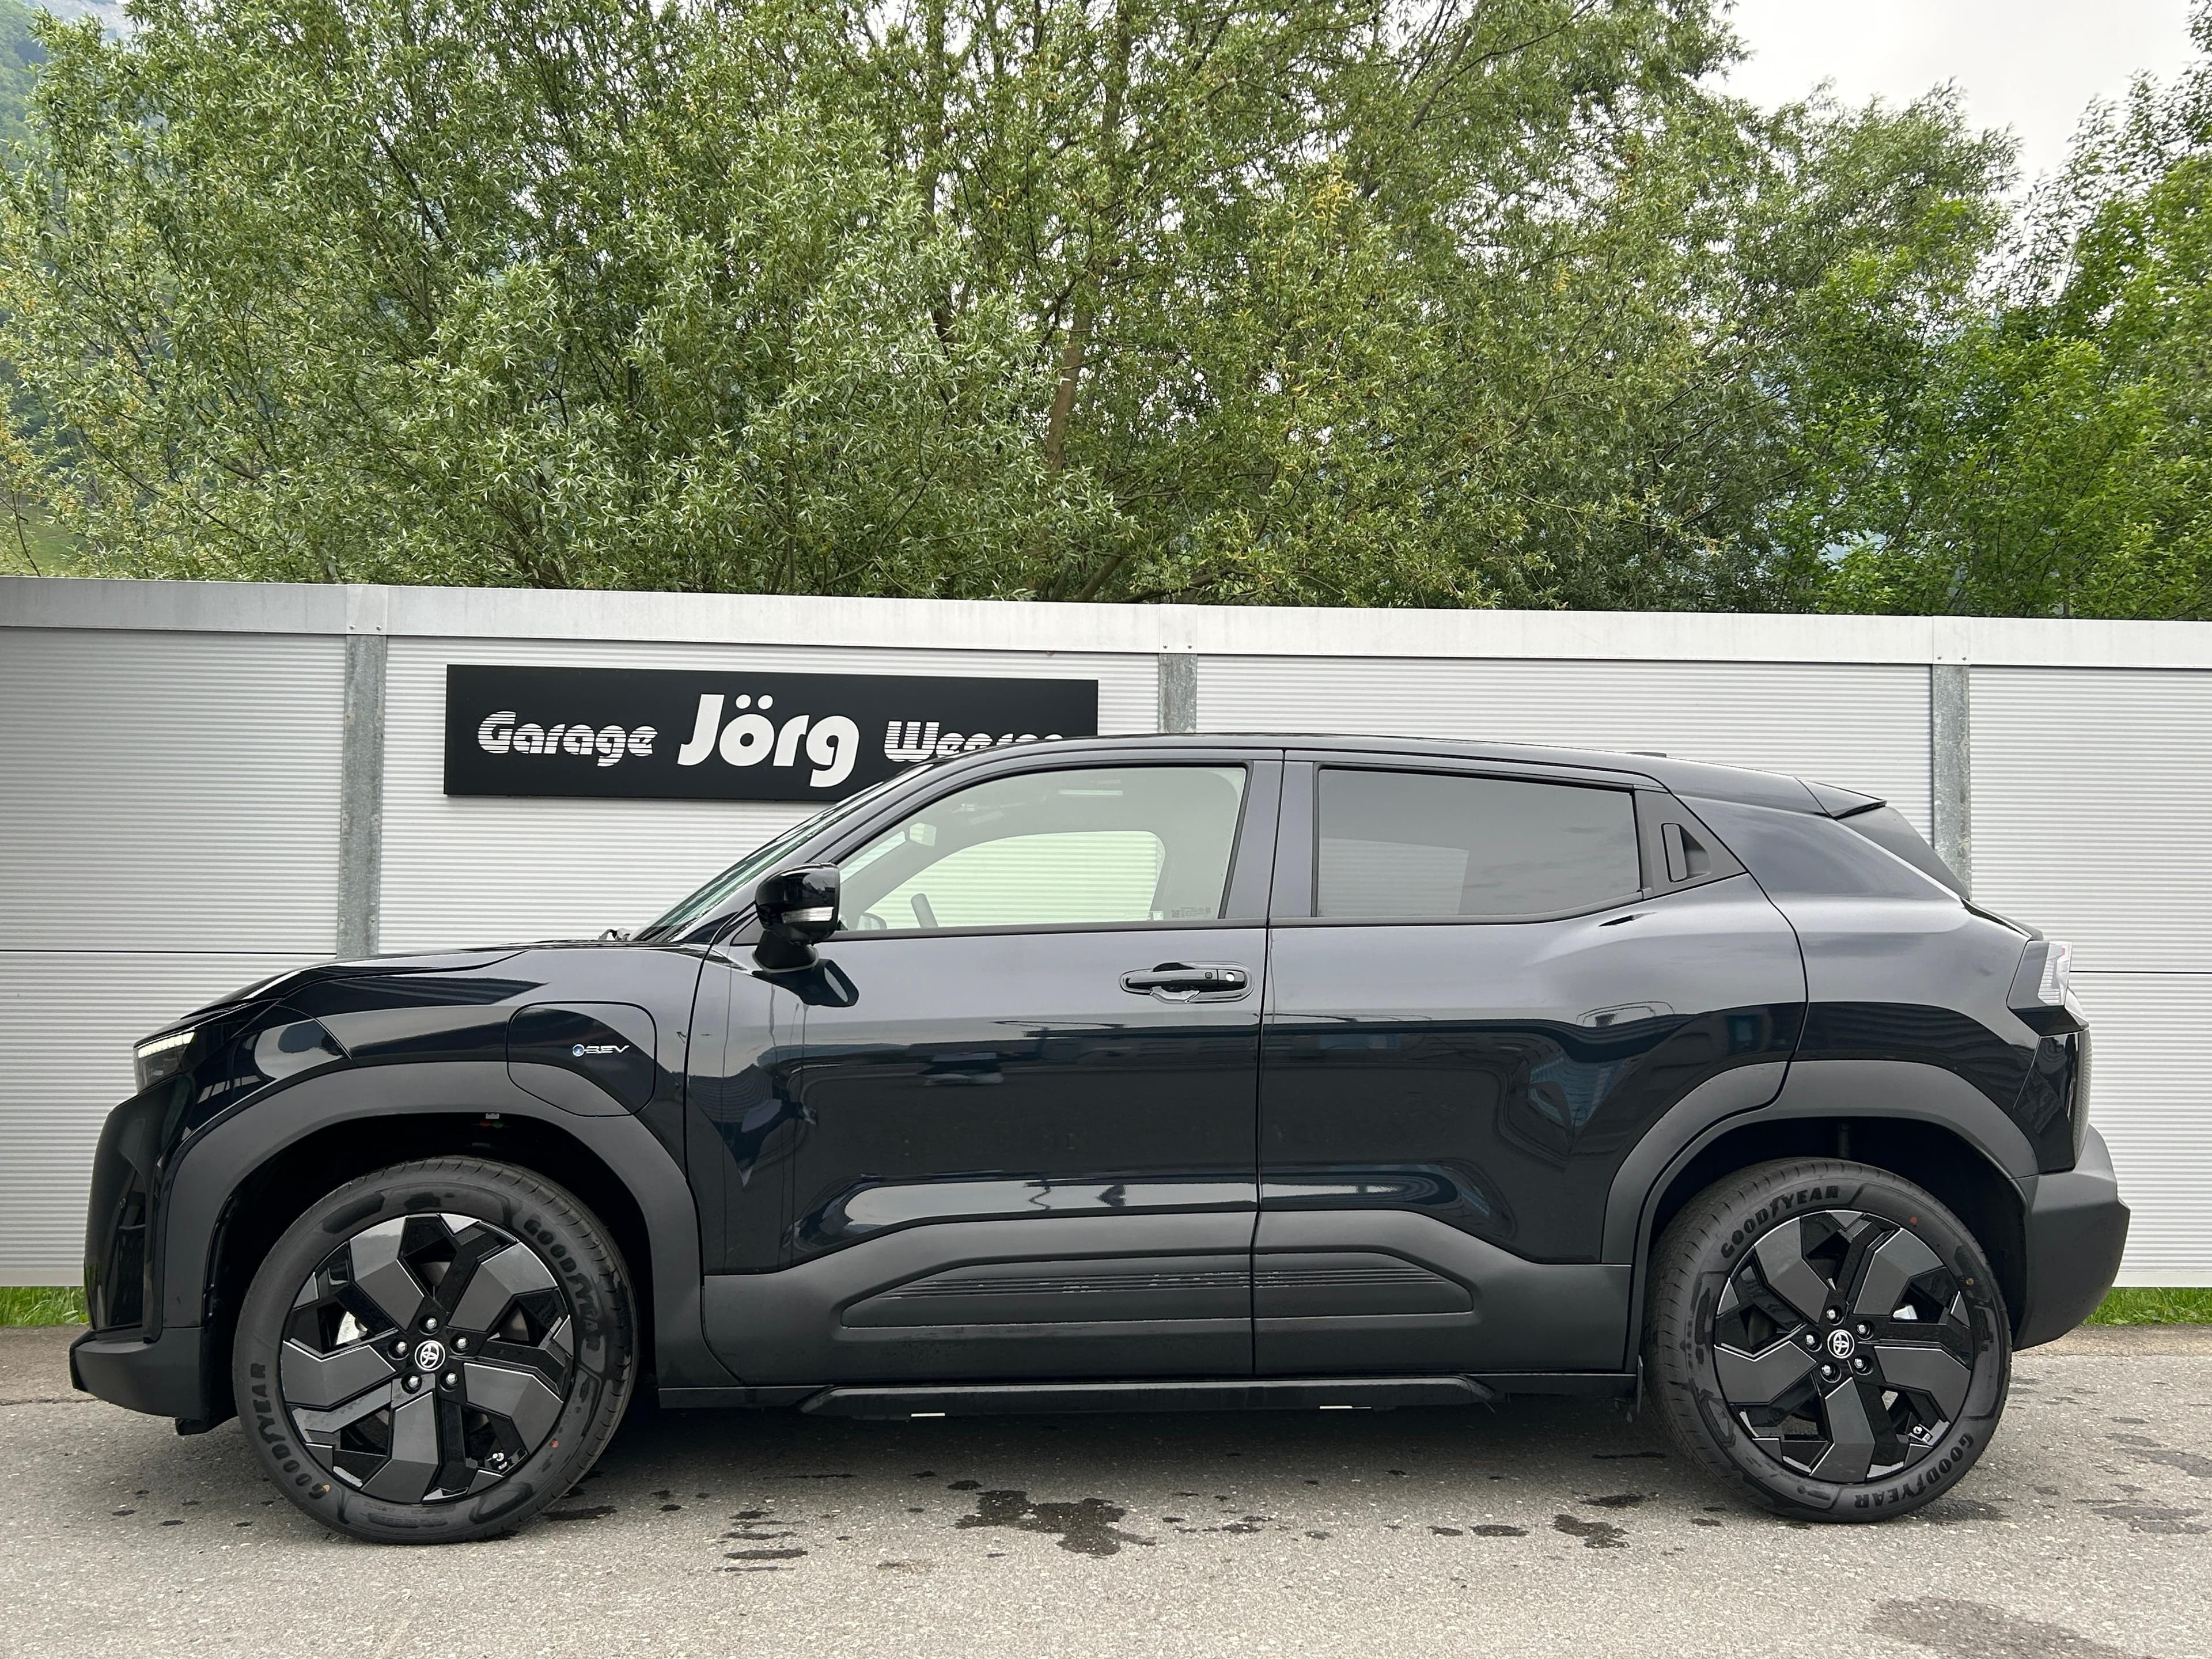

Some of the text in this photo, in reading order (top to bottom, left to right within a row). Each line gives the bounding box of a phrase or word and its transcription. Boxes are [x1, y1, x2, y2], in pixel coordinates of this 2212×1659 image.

[478, 711, 658, 767] Garage
[677, 694, 860, 788] Jörg
[1721, 1185, 1839, 1259] GOODYEAR
[250, 1363, 327, 1499] GOODYEAR
[1854, 1433, 1974, 1509] GOODYEAR
